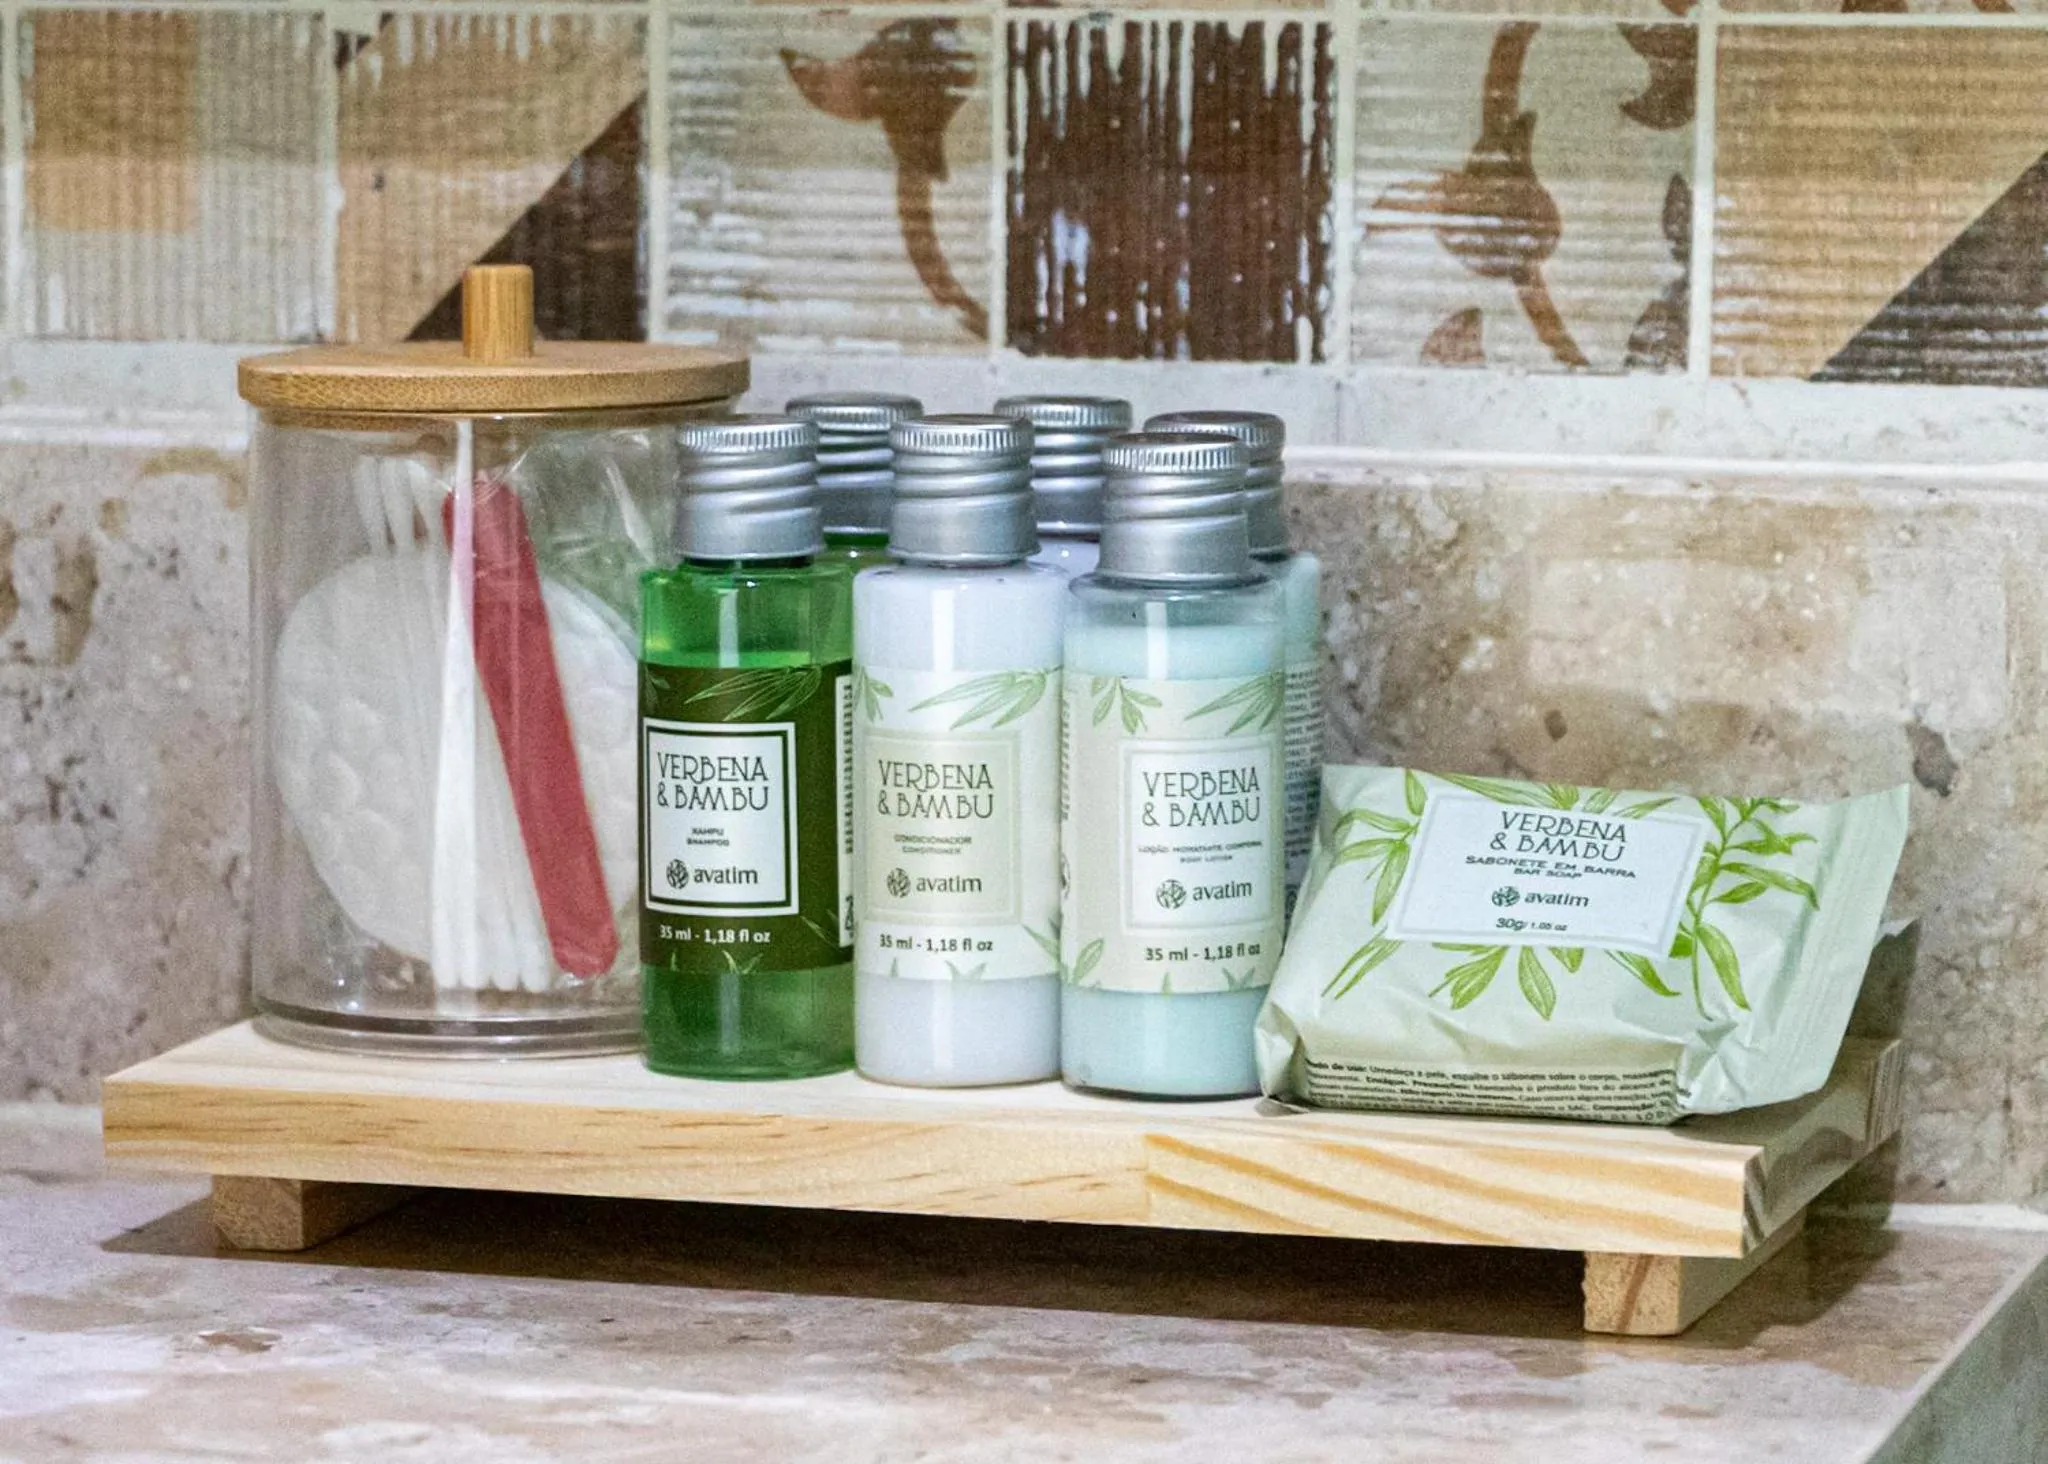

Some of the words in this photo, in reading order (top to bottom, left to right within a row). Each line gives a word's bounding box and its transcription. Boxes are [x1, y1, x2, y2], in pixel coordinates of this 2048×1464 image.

[657, 752, 769, 785] VERBENA
[878, 759, 994, 793] VERBENA
[657, 781, 669, 808] &
[674, 785, 769, 811] BAMBU
[1142, 767, 1261, 801] VERBENA
[878, 789, 891, 816] &
[897, 793, 994, 819] BAMBU
[1141, 802, 1160, 827] &
[1169, 797, 1261, 827] BAMBU
[1501, 810, 1627, 842] VERBENA
[1489, 832, 1507, 850] &
[1518, 834, 1626, 862] BAMBU
[694, 866, 759, 885] avatim
[1464, 855, 1548, 869] SABONETE
[1554, 862, 1577, 871] EM
[1584, 865, 1636, 879] BARRA
[1513, 867, 1542, 877] BAR
[1546, 870, 1582, 879] SOAP
[916, 874, 982, 893] avatim
[1192, 881, 1253, 901] avatim
[1524, 891, 1589, 908] avatim
[660, 925, 673, 940] 35
[675, 926, 692, 941] ml
[703, 928, 735, 945] 1,18
[738, 928, 750, 943] fl
[753, 931, 771, 943] oz
[879, 934, 893, 948] 35
[896, 934, 913, 949] ml
[926, 938, 957, 953] 1,18
[963, 937, 973, 951] fl
[976, 940, 993, 952] oz
[1145, 947, 1163, 961] 35
[1169, 947, 1188, 961] ml
[1204, 945, 1233, 962] 1,18
[1236, 944, 1245, 957] fl
[1248, 944, 1261, 955] oz
